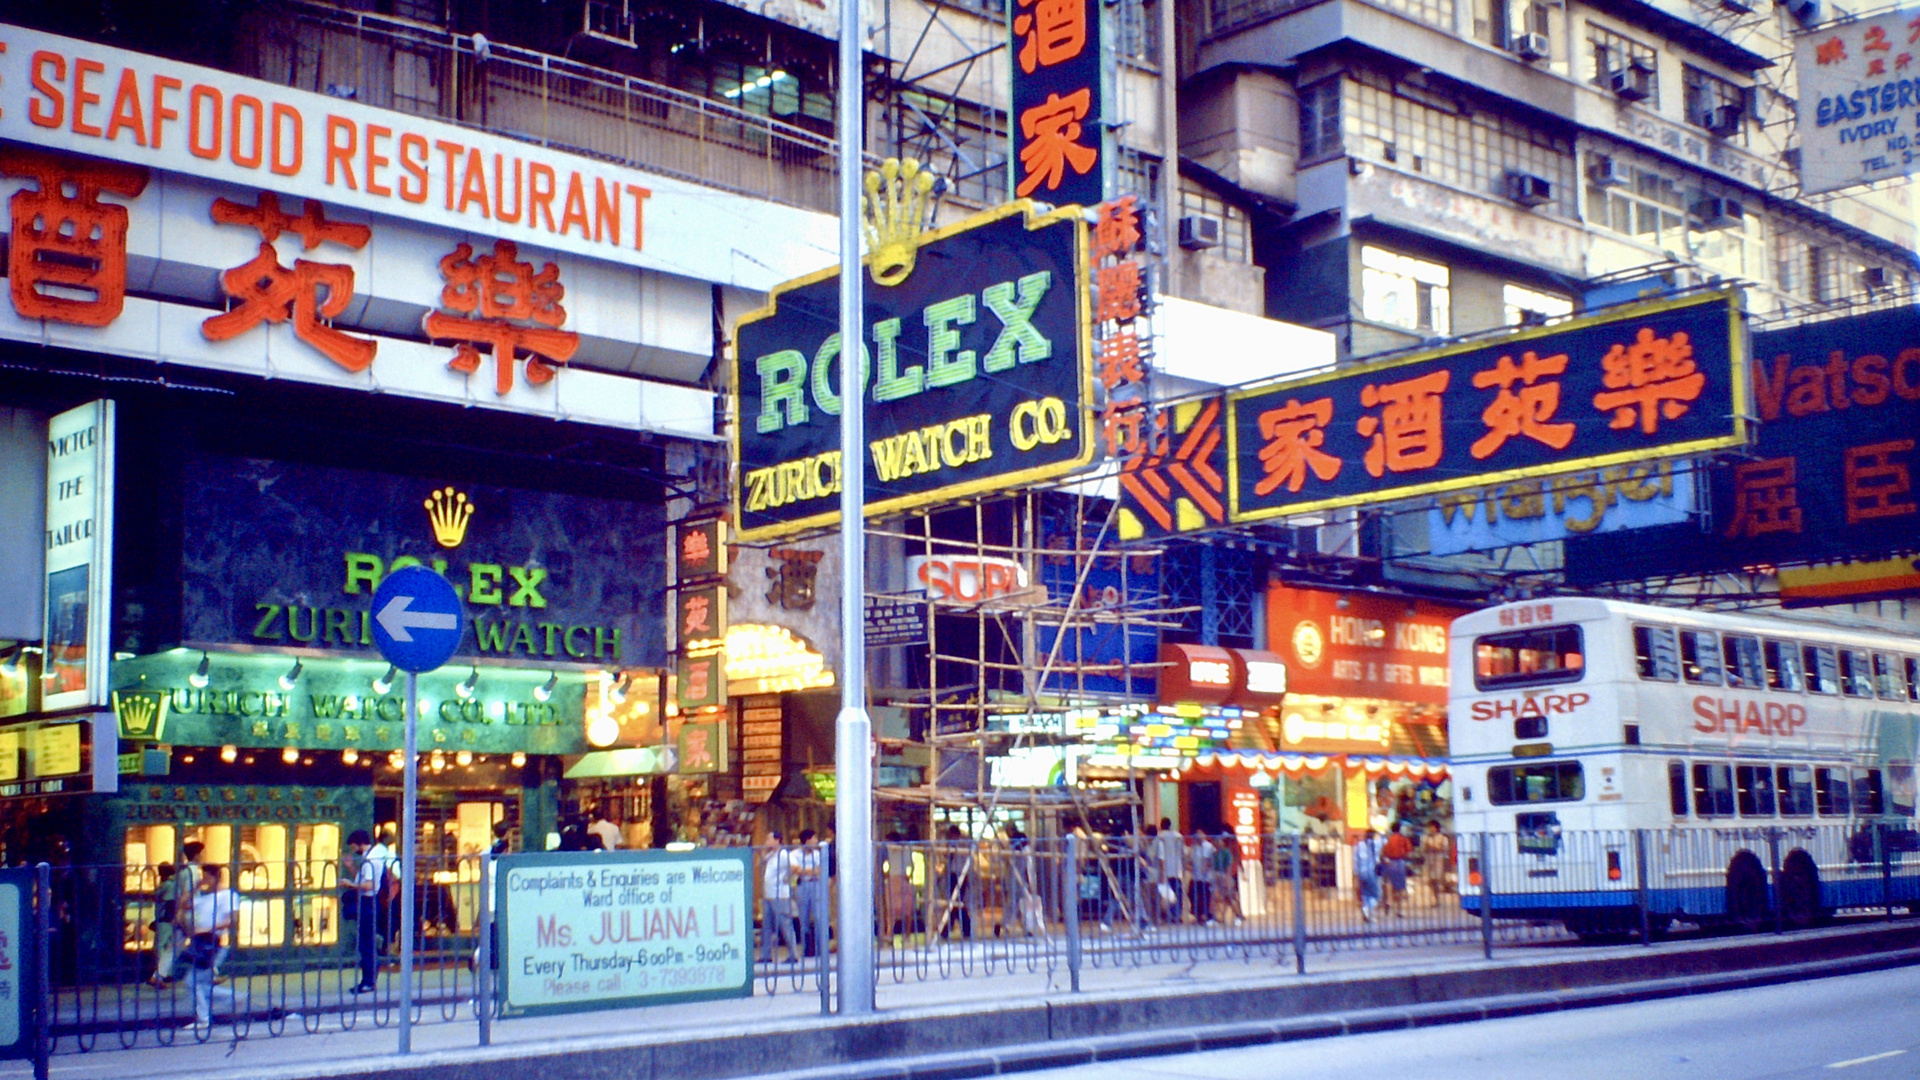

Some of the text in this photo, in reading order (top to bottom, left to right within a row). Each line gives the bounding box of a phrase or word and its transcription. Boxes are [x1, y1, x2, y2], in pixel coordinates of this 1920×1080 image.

[1840, 116, 1898, 144] IVORY
[29, 50, 303, 176] SEAFOOD
[326, 114, 652, 251] RESTAURANT
[756, 271, 1052, 434] ROLEX
[50, 425, 97, 459] VICTOR
[870, 412, 993, 482] WATCH
[1009, 397, 1072, 451] CO.
[59, 475, 84, 502] THE
[46, 518, 94, 550] TAILOR
[344, 552, 547, 608] REX
[253, 603, 622, 659] ZURI WATCH
[1330, 615, 1446, 654] HONG KONG
[170, 688, 291, 717] URICH
[506, 701, 564, 726] LTD.
[1471, 693, 1590, 721] SHARP
[1692, 695, 1807, 736] SHARP
[510, 866, 744, 895] Complaints & Enquiries are Welcome
[583, 887, 673, 907] Ward office of
[537, 904, 735, 948] Ms. JULIANA LI
[524, 956, 566, 979] Every
[543, 977, 591, 997] Please
